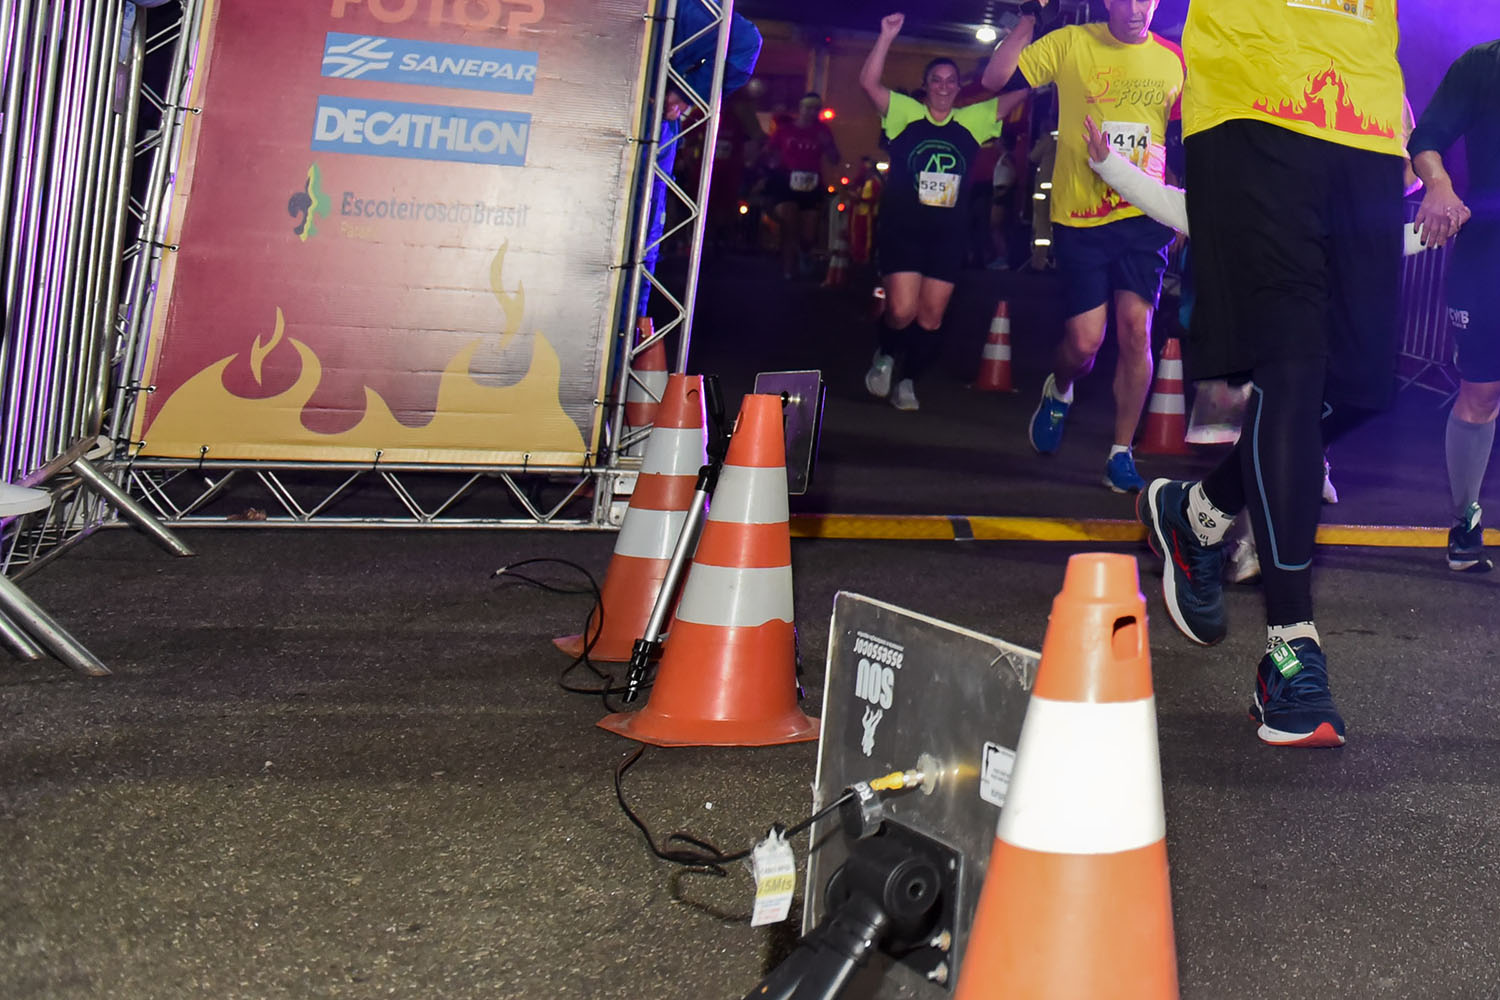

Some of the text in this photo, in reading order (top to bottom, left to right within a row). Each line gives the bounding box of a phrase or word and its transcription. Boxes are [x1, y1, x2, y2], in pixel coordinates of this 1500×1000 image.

[399, 52, 537, 83] SANEPAR
[314, 106, 528, 156] DECATHLON
[855, 657, 895, 710] SOU
